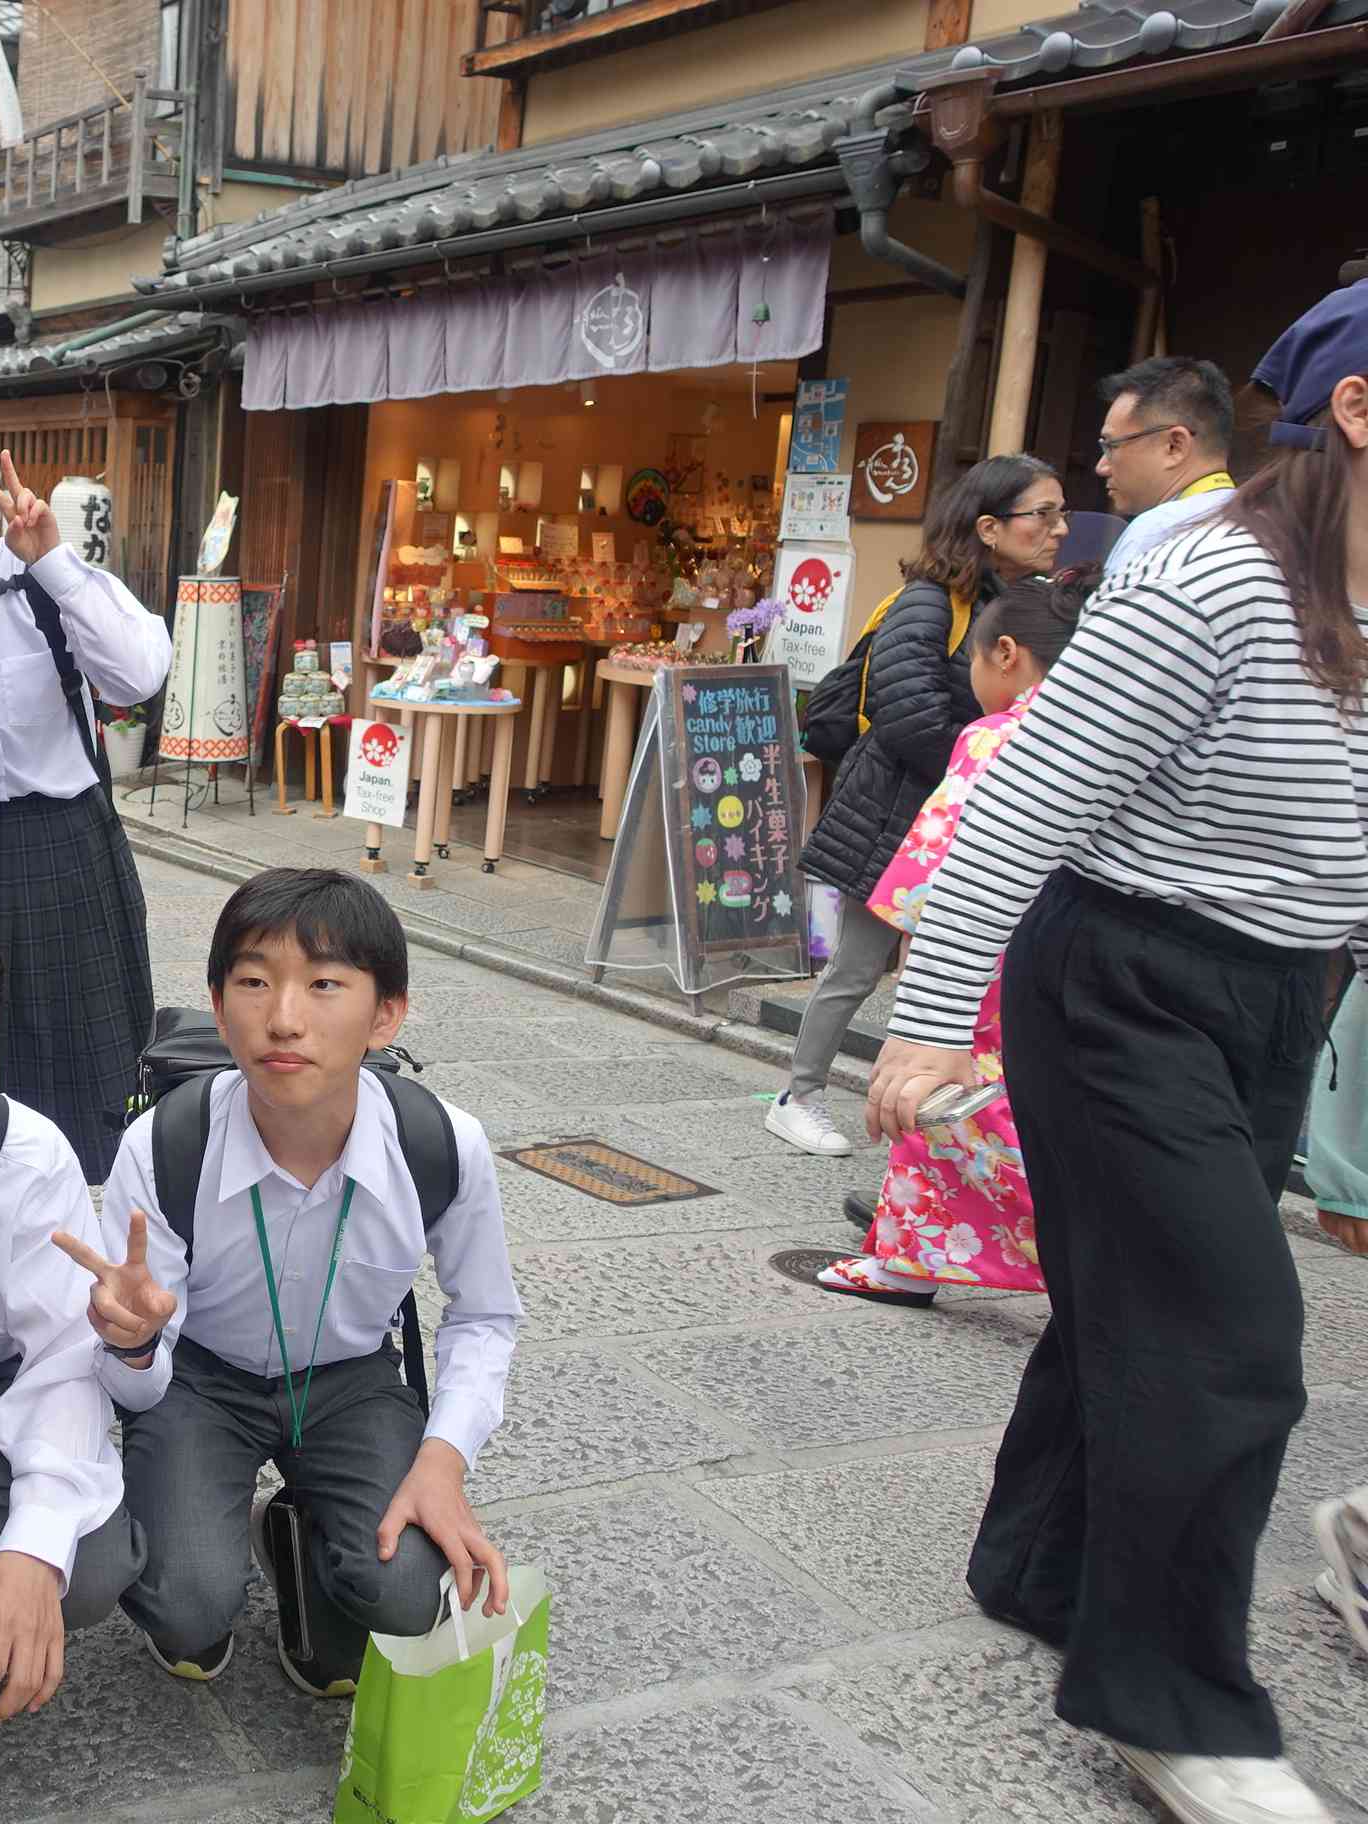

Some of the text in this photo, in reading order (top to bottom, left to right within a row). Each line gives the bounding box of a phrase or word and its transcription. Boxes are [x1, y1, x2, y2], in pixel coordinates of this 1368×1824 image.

[782, 638, 826, 656] Tax-free
[787, 656, 815, 674] Shop
[698, 686, 771, 716] 修学旅行
[686, 714, 732, 738] candy
[735, 714, 780, 744] 歓迎
[357, 785, 395, 803] Tax-free
[360, 801, 387, 817] Shop
[762, 743, 790, 875] 半生菓子
